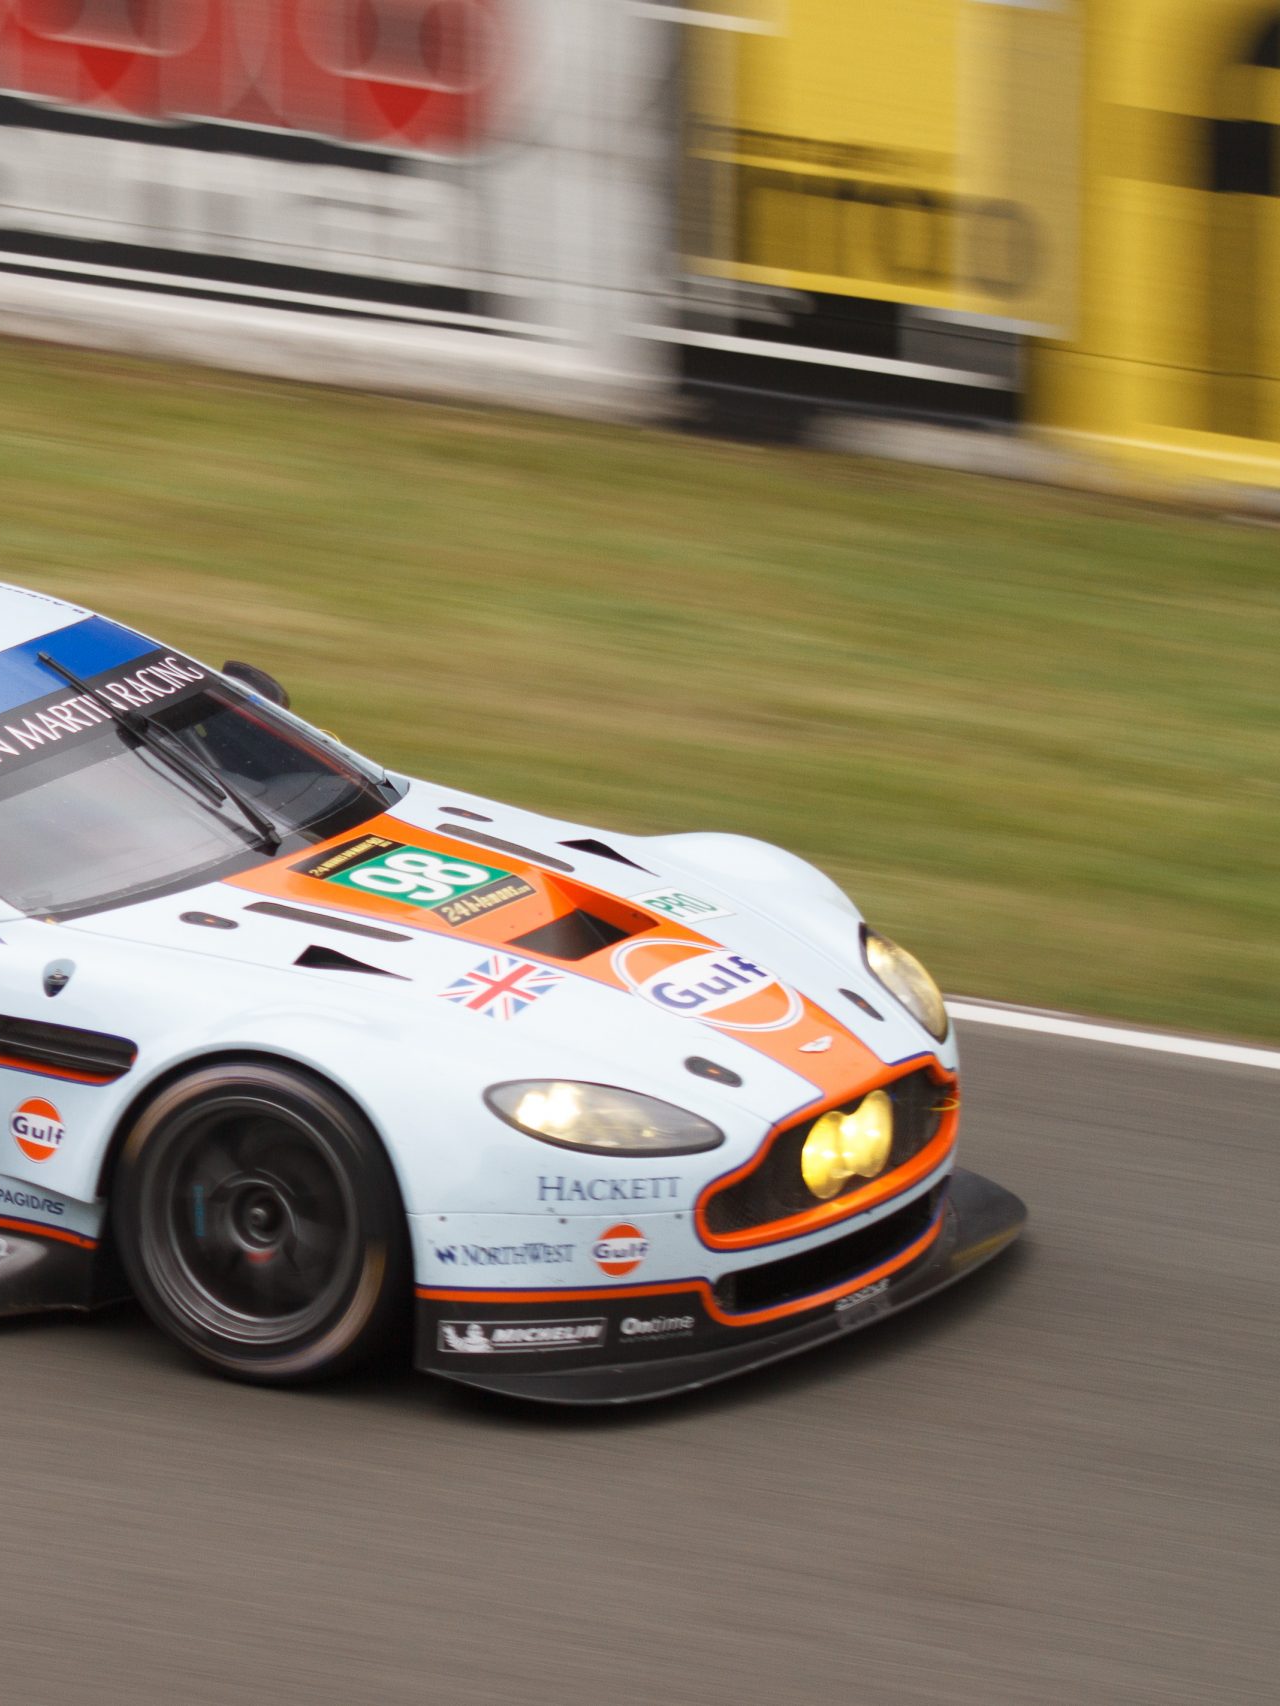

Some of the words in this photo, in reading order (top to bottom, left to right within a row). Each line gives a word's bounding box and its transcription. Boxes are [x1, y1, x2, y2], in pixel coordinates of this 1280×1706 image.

[3, 689, 128, 751] MARTIN
[105, 656, 205, 708] RACING
[348, 852, 492, 902] 98
[642, 892, 718, 918] PRO
[650, 955, 768, 1010] Gulf
[12, 1115, 64, 1145] Gulf
[537, 1175, 682, 1202] HACKETT
[460, 1242, 577, 1267] NORTHWEST
[591, 1242, 649, 1260] Gulf
[491, 1325, 603, 1344] MICHELIN
